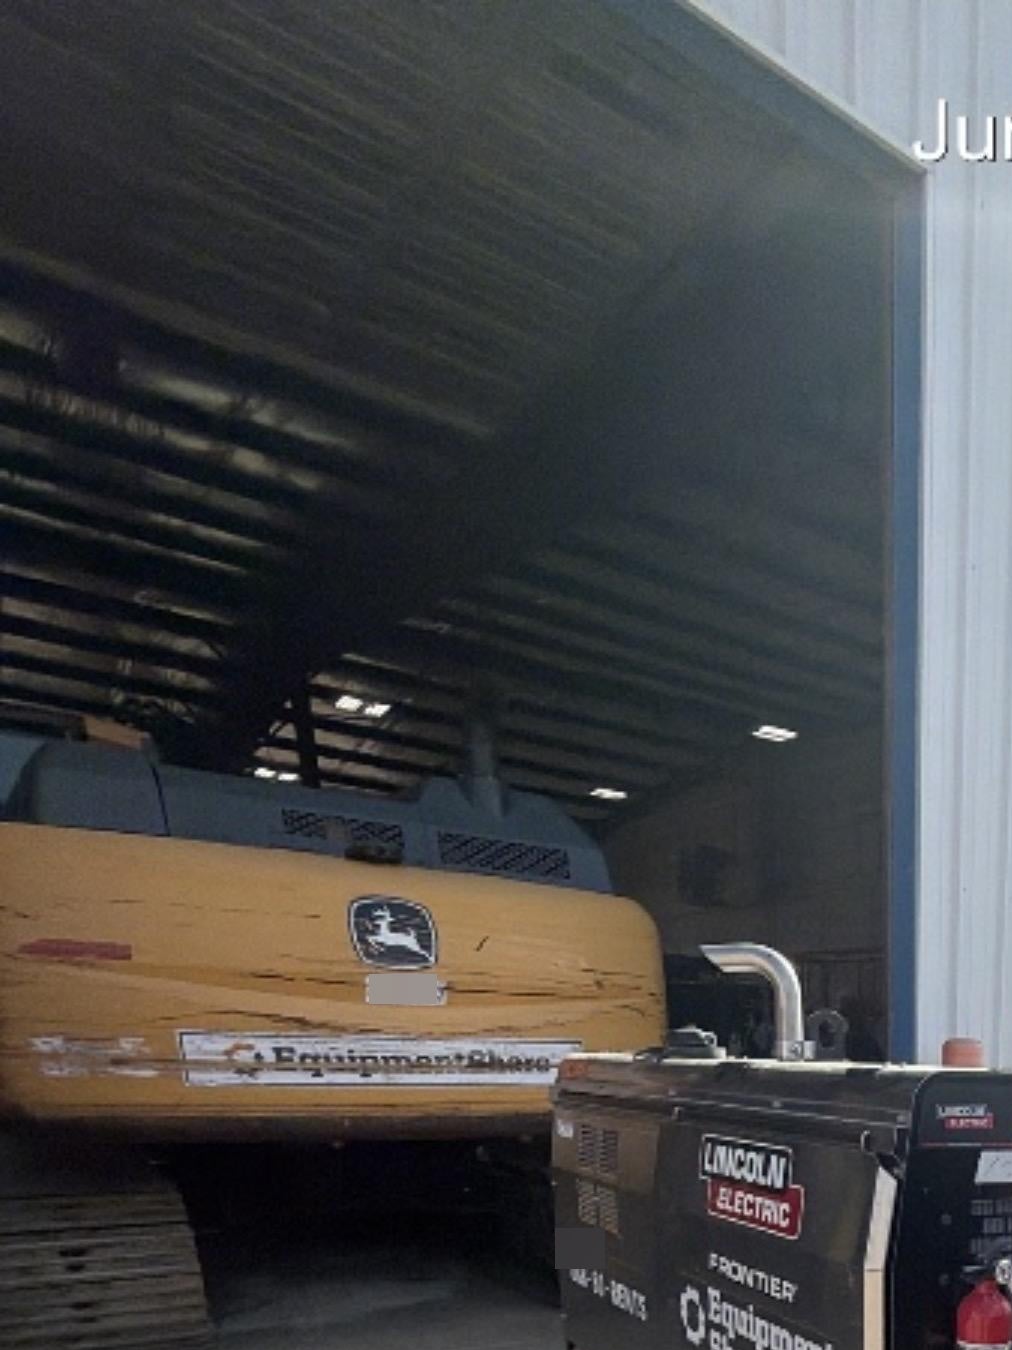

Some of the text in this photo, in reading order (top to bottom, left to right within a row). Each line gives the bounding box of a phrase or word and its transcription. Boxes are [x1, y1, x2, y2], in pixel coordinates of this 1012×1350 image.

[703, 1143, 787, 1188] LINCOLN
[716, 1186, 791, 1228] ELECTRIC
[708, 1253, 798, 1302] FRONTIER
